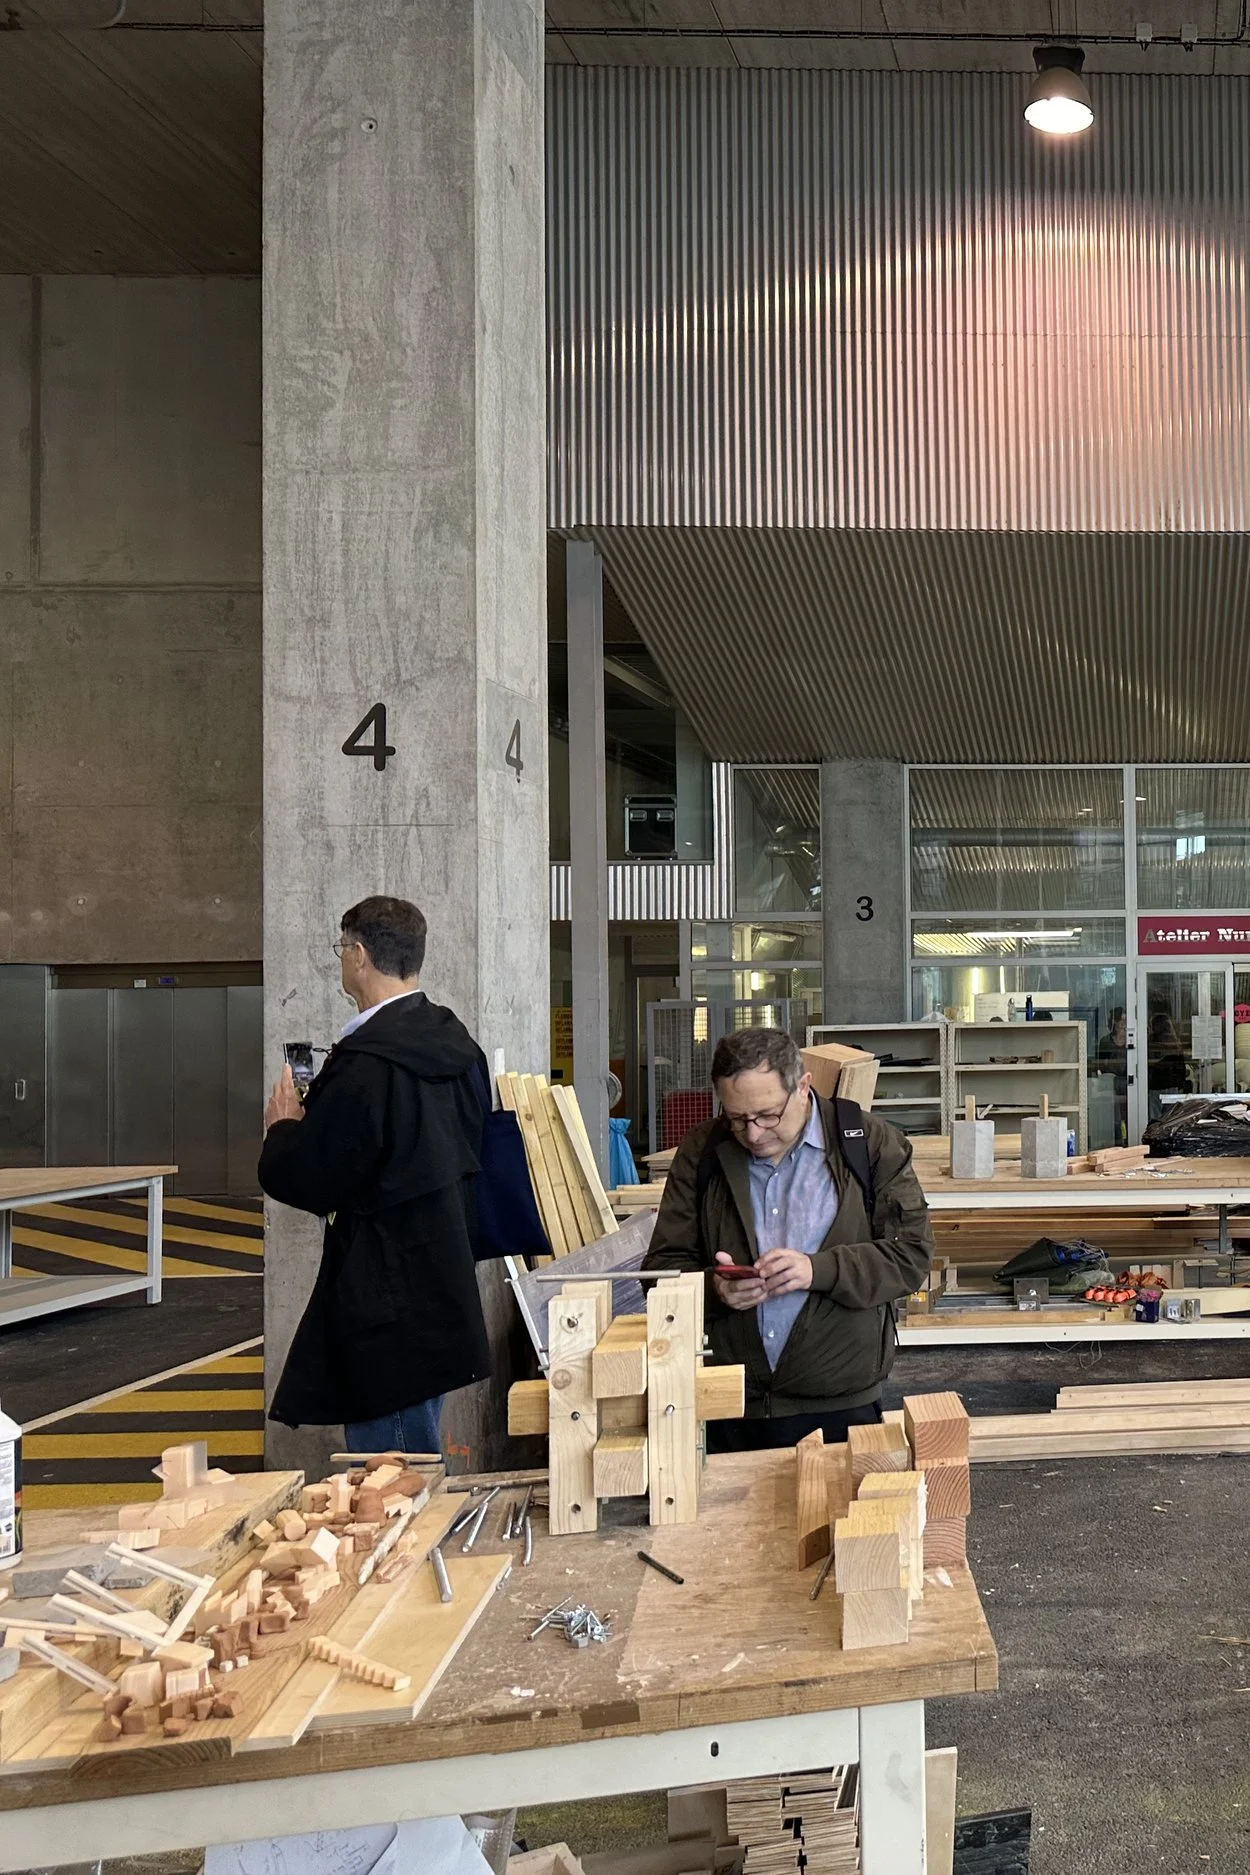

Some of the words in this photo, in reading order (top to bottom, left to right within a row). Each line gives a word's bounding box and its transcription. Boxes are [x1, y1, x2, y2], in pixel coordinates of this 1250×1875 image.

[341, 702, 396, 771] 4
[505, 719, 524, 783] 4
[856, 896, 874, 921] 3
[1143, 928, 1210, 943] Atelier
